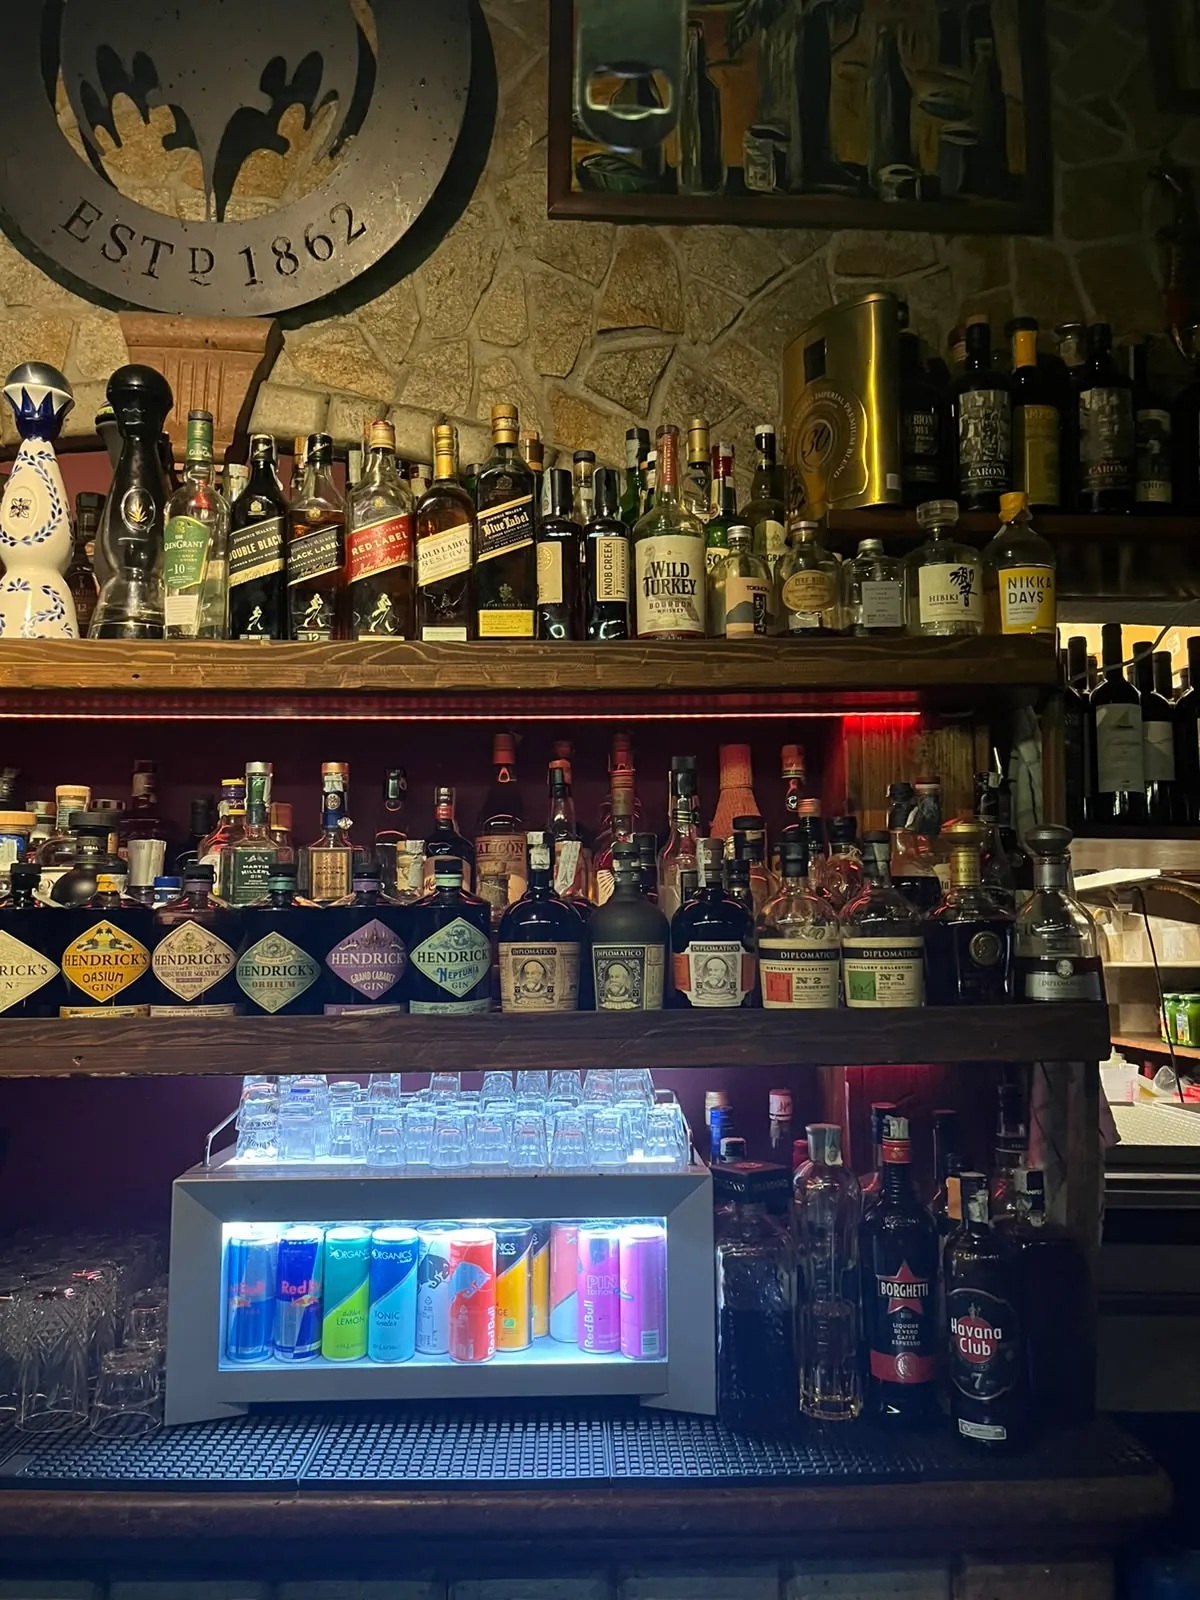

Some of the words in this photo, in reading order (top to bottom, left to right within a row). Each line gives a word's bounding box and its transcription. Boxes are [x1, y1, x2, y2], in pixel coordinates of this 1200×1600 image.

[238, 202, 367, 286] 1862
[481, 520, 506, 537] Blue
[504, 511, 530, 528] Label
[257, 534, 284, 552] BLACK
[314, 540, 342, 554] LABEL
[351, 542, 373, 557] RED
[374, 531, 410, 548] LABEL
[441, 537, 473, 552] LABEL
[421, 546, 471, 567] RESERVE
[603, 542, 613, 570] CREEK
[173, 563, 186, 575] 10
[650, 561, 690, 579] WILD
[603, 572, 613, 596] KNOB
[643, 576, 697, 597] TURKEY
[1008, 575, 1053, 590] NIKKA
[929, 594, 959, 603] HIBIKI
[1008, 590, 1045, 605] DAYS
[649, 601, 692, 610] BOURBON
[307, 632, 321, 641] 12
[64, 953, 148, 967] HENDRICK'S
[154, 953, 231, 966] HENDRICK'S
[82, 971, 124, 984] OASIUM
[239, 964, 315, 977] HENDRICK'S
[350, 971, 372, 984] GRAND
[371, 970, 397, 983] CABARET
[435, 965, 480, 984] NEPTUNIA
[363, 982, 384, 991] GIN
[451, 982, 469, 990] GIN
[373, 1248, 413, 1261] ORGANICS
[281, 1280, 307, 1295] Red
[880, 1281, 929, 1298] BORGHETTI
[374, 1310, 400, 1321] TONIC
[487, 1306, 496, 1330] Bull
[584, 1300, 594, 1324] Bull
[336, 1316, 365, 1327] LEMON
[892, 1322, 919, 1330] LIQUORE
[950, 1317, 1002, 1340] Havana
[487, 1330, 496, 1356] Red
[584, 1324, 594, 1349] Red
[959, 1338, 992, 1357] Club
[971, 1373, 983, 1390] 7
